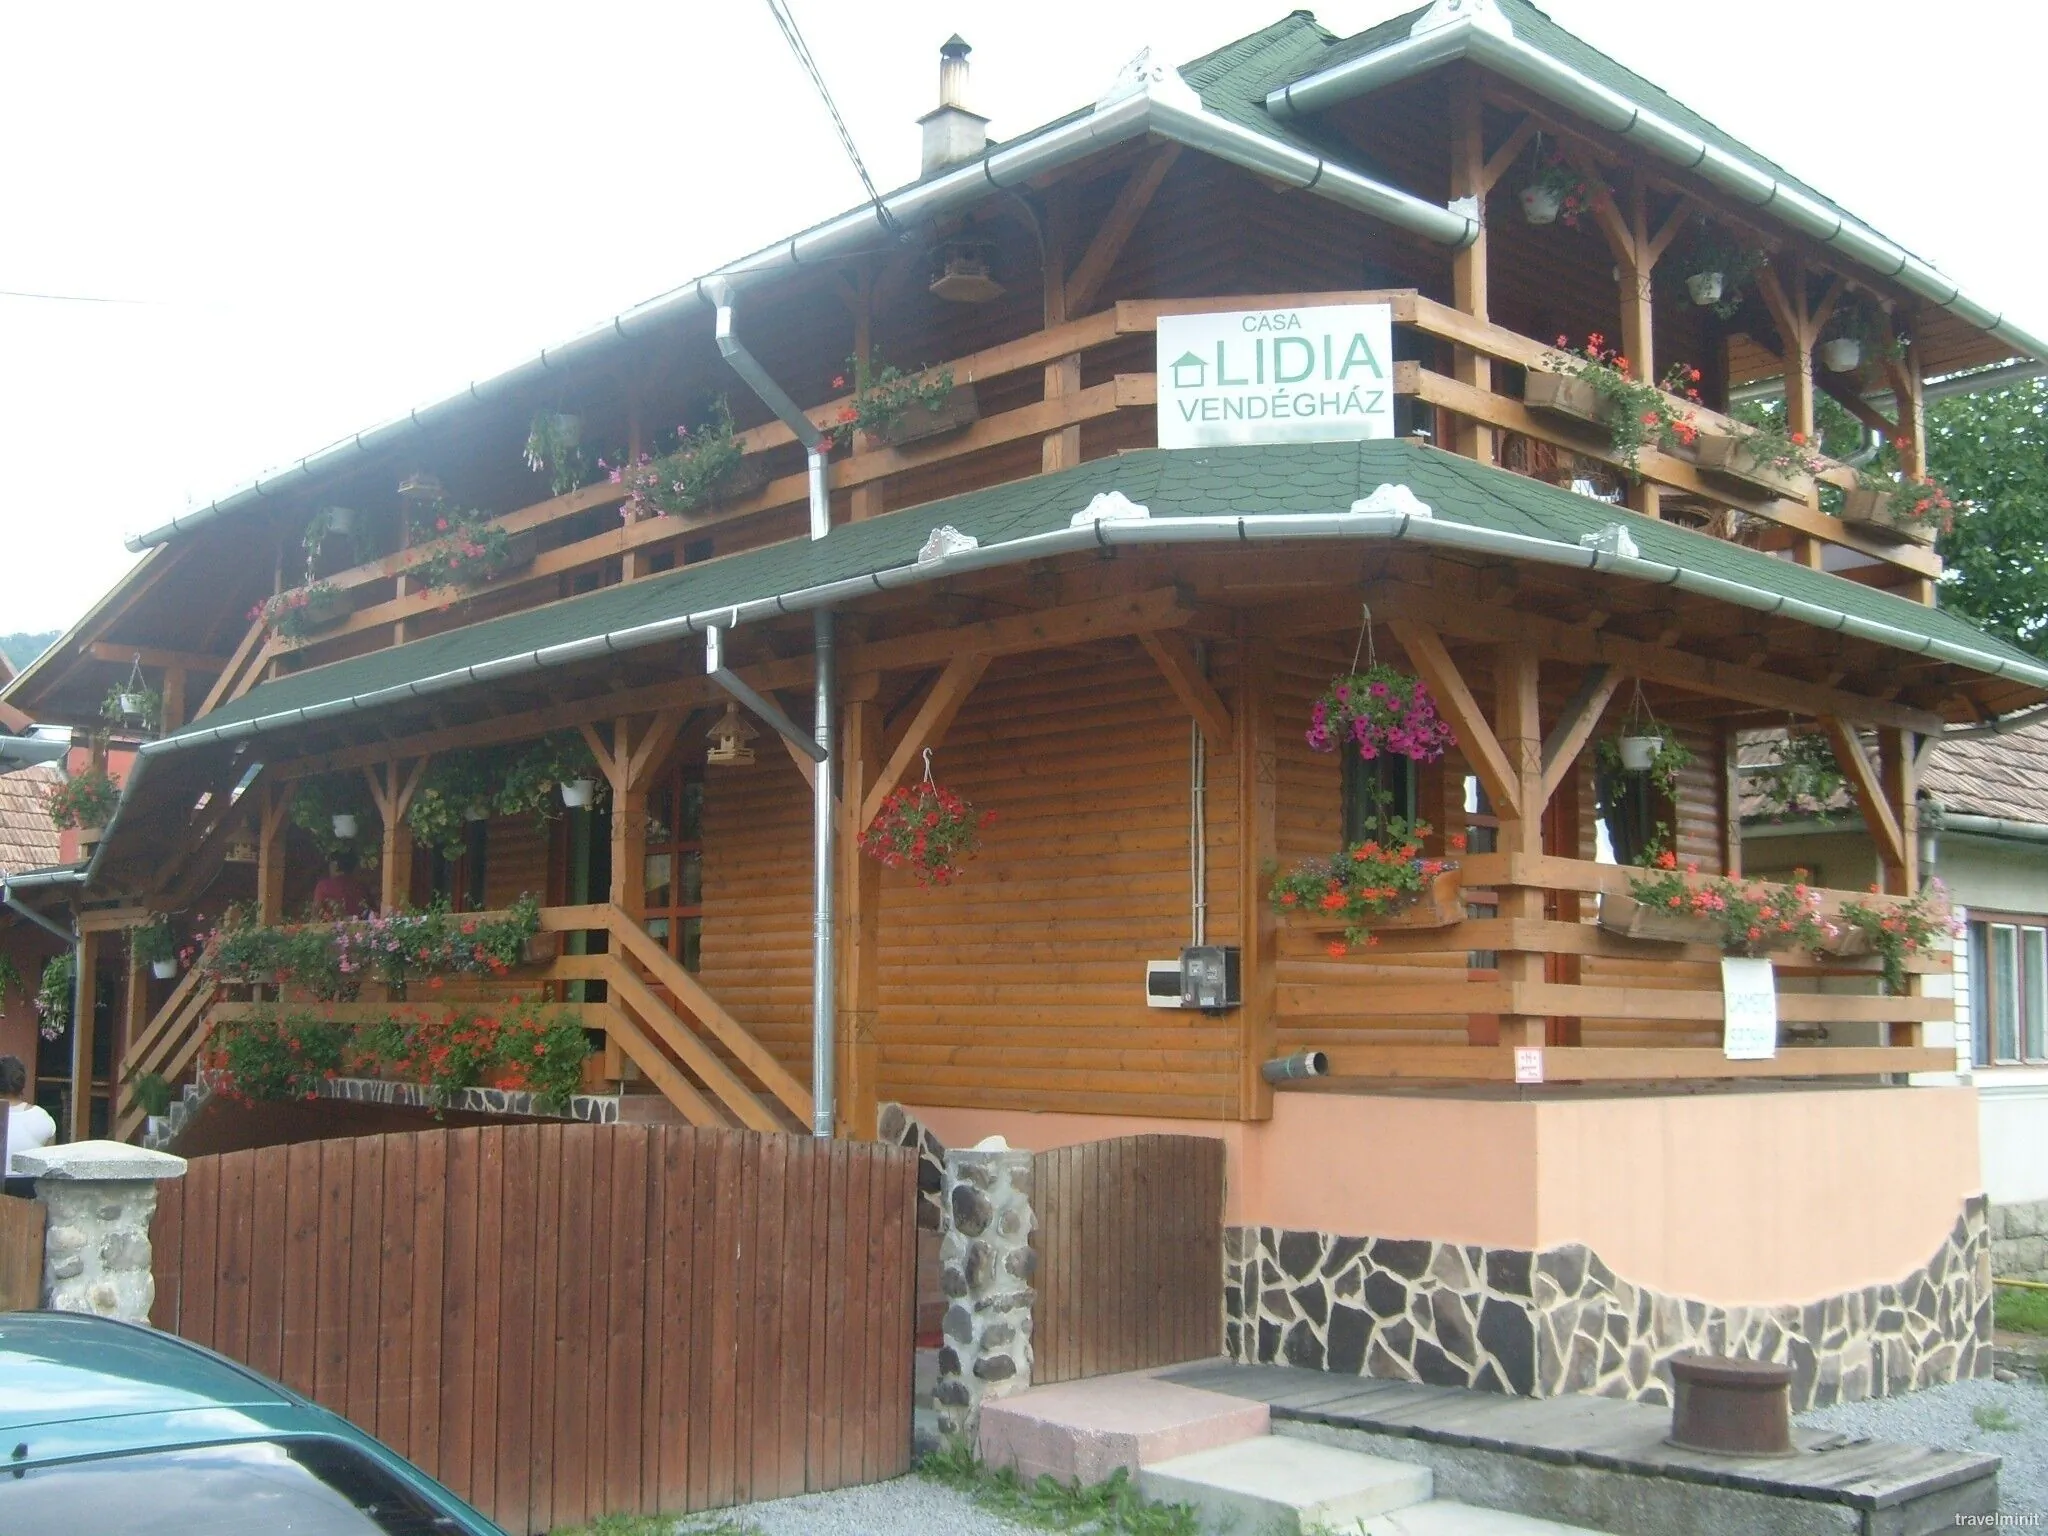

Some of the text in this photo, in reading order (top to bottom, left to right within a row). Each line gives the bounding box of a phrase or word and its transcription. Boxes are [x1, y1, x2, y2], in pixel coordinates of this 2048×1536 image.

[1242, 313, 1302, 332] CASA
[1216, 333, 1384, 386] LIDIA
[1177, 385, 1385, 422] VENDÉGHÁZ
